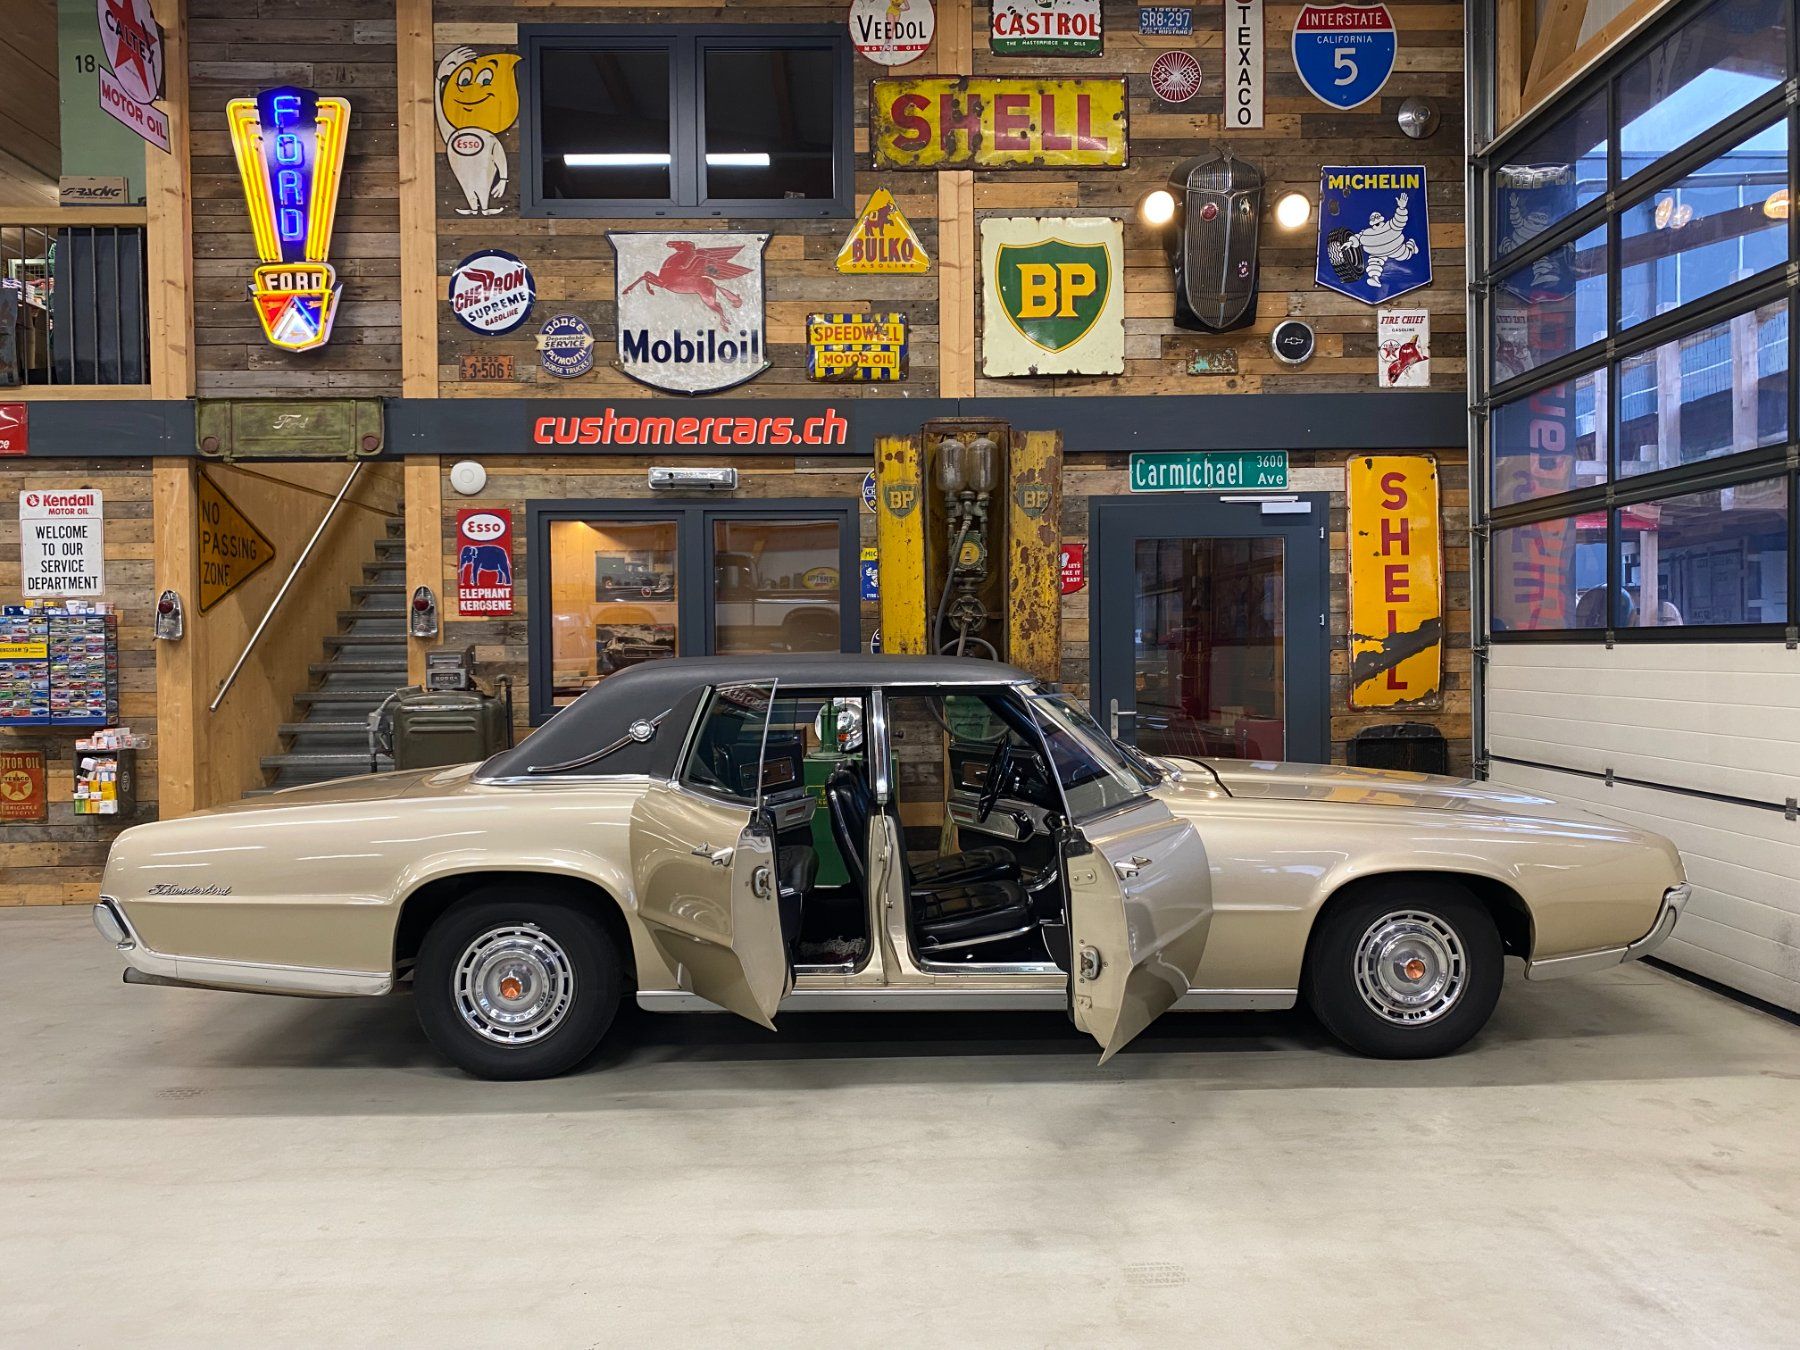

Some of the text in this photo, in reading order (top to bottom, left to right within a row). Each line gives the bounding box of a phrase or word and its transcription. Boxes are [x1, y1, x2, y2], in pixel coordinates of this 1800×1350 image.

[994, 12, 1099, 37] CASTROL
[1305, 12, 1383, 26] INTERSTATE
[104, 9, 155, 65] CALTEX
[857, 14, 927, 43] VEEDOL
[1316, 35, 1373, 44] CALIFORNIA
[75, 54, 95, 73] 18
[1237, 6, 1251, 125] TEXACO
[1333, 47, 1359, 86] 5
[101, 79, 168, 140] MOTOR OIL
[890, 93, 1109, 151] SHELL
[273, 95, 306, 241] FORD
[1328, 174, 1420, 190] MICHELIN
[852, 237, 914, 263] BULKO
[264, 271, 323, 291] FORD
[454, 266, 526, 312] CHEVRON
[1017, 263, 1096, 319] BP
[468, 291, 527, 323] SUPREME
[484, 307, 519, 327] GASOLINE
[545, 317, 585, 335] DODGE
[1380, 315, 1425, 324] FIRE CHIEF
[815, 325, 900, 343] SPEEDWELL
[544, 340, 586, 348] SERVICE
[622, 329, 759, 364] Mobiloil
[546, 350, 587, 365] PLYMOUTH
[824, 353, 895, 365] MOTOR OIL
[470, 363, 504, 378] 3-506
[544, 360, 590, 374] DODGE TRUCKS
[272, 413, 309, 430] Ford
[533, 407, 848, 445] customercars.ch
[1136, 455, 1283, 487] Carmichael 3600
[1257, 473, 1284, 485] Ave
[43, 494, 94, 506] Kendall
[890, 491, 914, 509] BP
[1023, 490, 1048, 509] BP
[202, 501, 220, 526] NO
[35, 526, 88, 539] WELCOME
[42, 543, 83, 556] TO OUR
[202, 531, 257, 560] PASSING
[41, 560, 84, 573] SERVICE
[203, 562, 231, 586] ZONE
[28, 577, 98, 590] DEPARTMENT
[1380, 471, 1411, 691] SHELL
[459, 588, 511, 600] ELEPHANT
[460, 600, 512, 611] KEROSENE
[0, 757, 40, 769] OTOR OIL
[148, 884, 232, 896] Thunderbird
